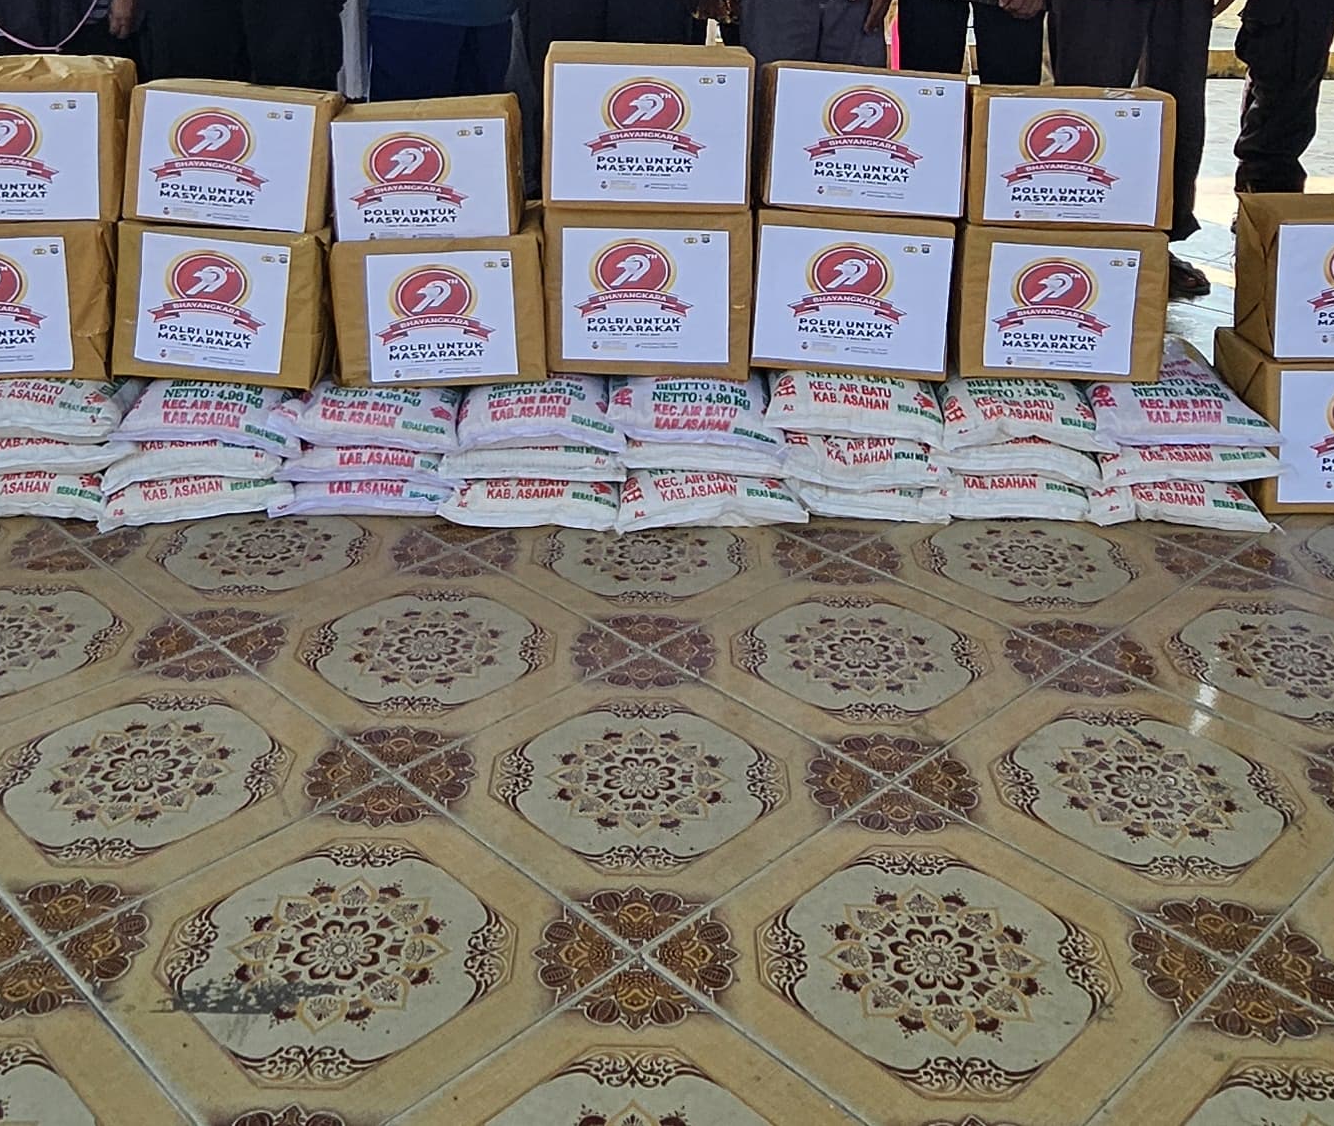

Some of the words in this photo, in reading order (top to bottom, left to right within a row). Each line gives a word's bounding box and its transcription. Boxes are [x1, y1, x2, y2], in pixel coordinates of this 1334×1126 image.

[610, 132, 679, 141] BHAYANGKARA
[597, 154, 639, 165] POLRI
[644, 156, 692, 166] UNTUK
[175, 161, 243, 173] BHAYANGKARA
[596, 162, 693, 174] MASYARAKAT
[1026, 164, 1094, 173] BHAYANGKARA
[0, 182, 46, 191] UNTUK
[160, 182, 202, 193] POLRI
[207, 186, 254, 198] UNTUK
[374, 184, 442, 193] BHAYANGKARA
[1012, 185, 1054, 196] POLRI
[1058, 186, 1105, 197] UNTUK
[159, 189, 255, 204] MASYARAKAT
[1010, 193, 1106, 205] MASYARAKAT
[364, 208, 405, 218] POLRI
[409, 207, 456, 217] UNTUK
[363, 214, 457, 225] MASYARAKAT
[599, 294, 667, 302] BHAYANGKARA
[587, 316, 629, 325] POLRI
[633, 316, 681, 325] UNTUK
[587, 324, 682, 333] MASYARAKAT
[11, 381, 28, 390] AIR
[31, 383, 65, 396] BATU
[730, 386, 747, 397] kg
[809, 380, 837, 391] KEC.
[839, 383, 859, 394] AIR
[861, 385, 892, 399] BATU
[7, 389, 57, 406] ASAHAN
[247, 394, 264, 409] kg
[734, 395, 751, 410] kg
[813, 391, 841, 403] KAB.
[842, 394, 889, 411] ASAHAN
[897, 403, 919, 414] BERAS
[1023, 398, 1054, 411] BATU
[705, 405, 737, 418] BATU
[1009, 408, 1053, 423] ASAHAN
[1169, 449, 1214, 462] ASAHAN
[1219, 452, 1243, 462] BERAS
[653, 477, 683, 490] KEC.
[684, 474, 704, 485] AIR
[990, 476, 1037, 490] ASAHAN
[1175, 481, 1205, 494] BATU
[0, 481, 51, 495] ASAHAN
[56, 486, 78, 497] BERAS
[142, 488, 171, 502] KAB.
[173, 481, 223, 499] ASAHAN
[486, 487, 512, 500] KAB.
[515, 486, 564, 499] ASAHAN
[571, 491, 593, 502] BERAS
[660, 489, 690, 503] KAB.
[691, 482, 738, 498] ASAHAN
[746, 487, 768, 499] BERAS
[1159, 491, 1205, 507] ASAHAN
[1212, 499, 1235, 509] BERAS
